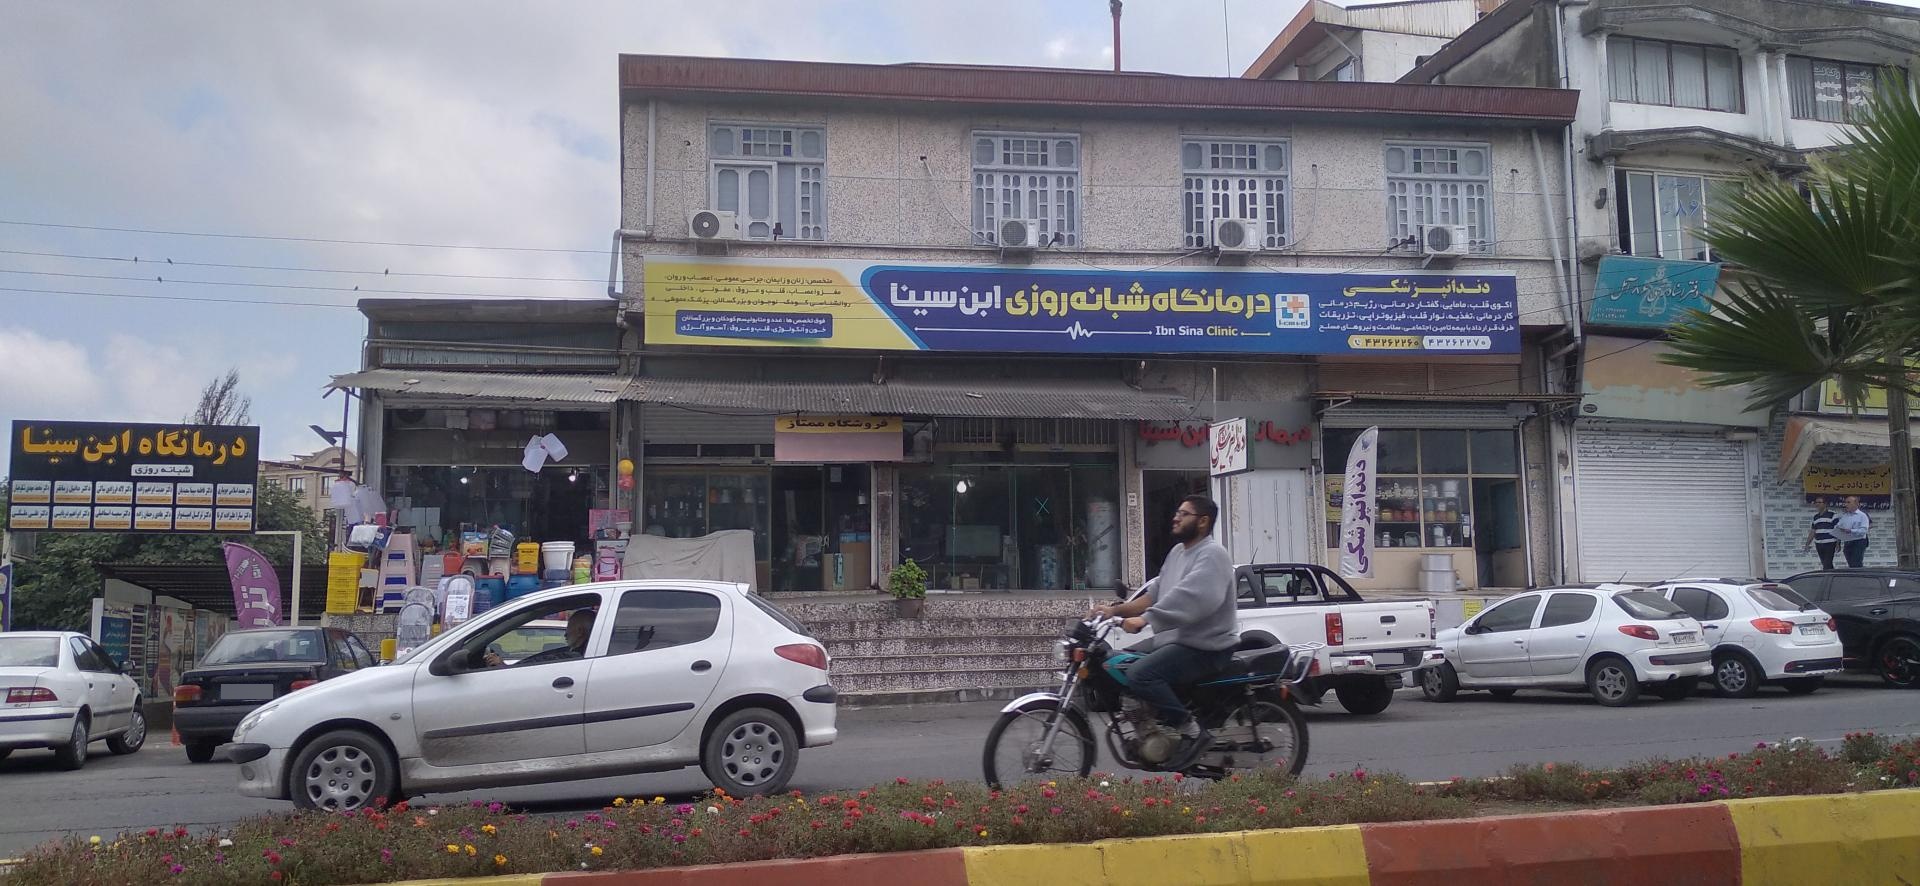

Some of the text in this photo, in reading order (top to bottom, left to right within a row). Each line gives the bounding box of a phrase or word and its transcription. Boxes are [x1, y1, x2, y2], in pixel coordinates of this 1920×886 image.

[1343, 278, 1490, 299] دندانپزشکی
[890, 281, 1271, 320] درمانگاه شبانه روزی ابن سینا
[1318, 299, 1354, 309] درمانی
[1416, 299, 1440, 309] گفتار
[1319, 310, 1356, 320] تزریقات
[1428, 312, 1445, 321] نوار
[1155, 325, 1238, 337] Ibn Sina Clinic
[1318, 322, 1340, 333] مسلح
[1365, 338, 1419, 348] ۴۳۲۶۲۲۶۰
[1428, 338, 1486, 348] ۴۳۲۶۲۲۷۰
[787, 418, 888, 429] فروشگاه ممتاز
[22, 427, 247, 465] درمانگاه ابن سینا
[134, 466, 191, 475] شبانه روزی
[1347, 460, 1371, 574] دندانپزشکی
